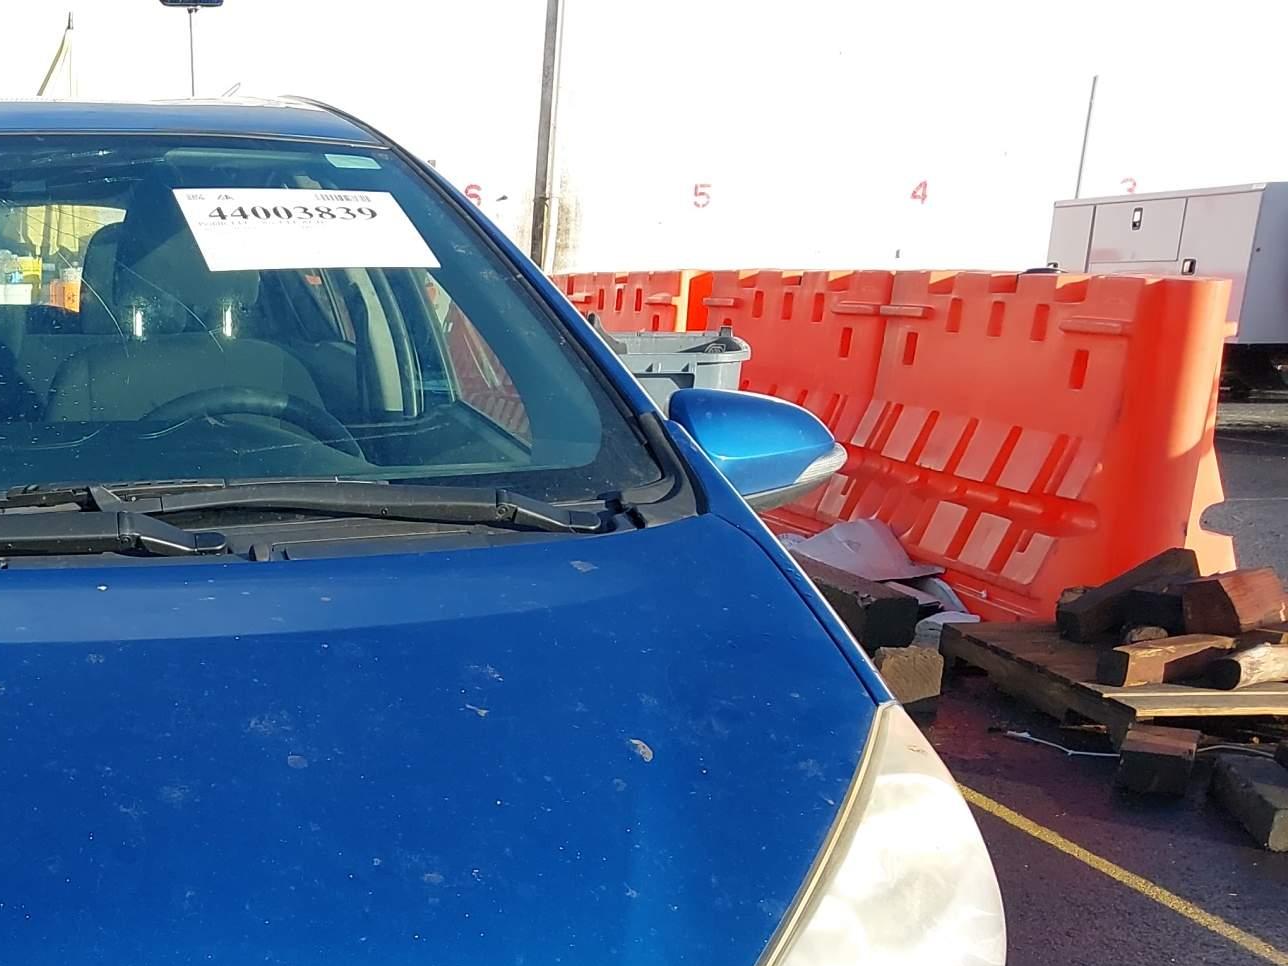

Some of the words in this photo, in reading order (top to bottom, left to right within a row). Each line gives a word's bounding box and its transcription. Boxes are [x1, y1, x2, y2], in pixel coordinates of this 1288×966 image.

[693, 183, 712, 208] 5
[911, 180, 927, 205] 4
[208, 205, 378, 221] 44003839
